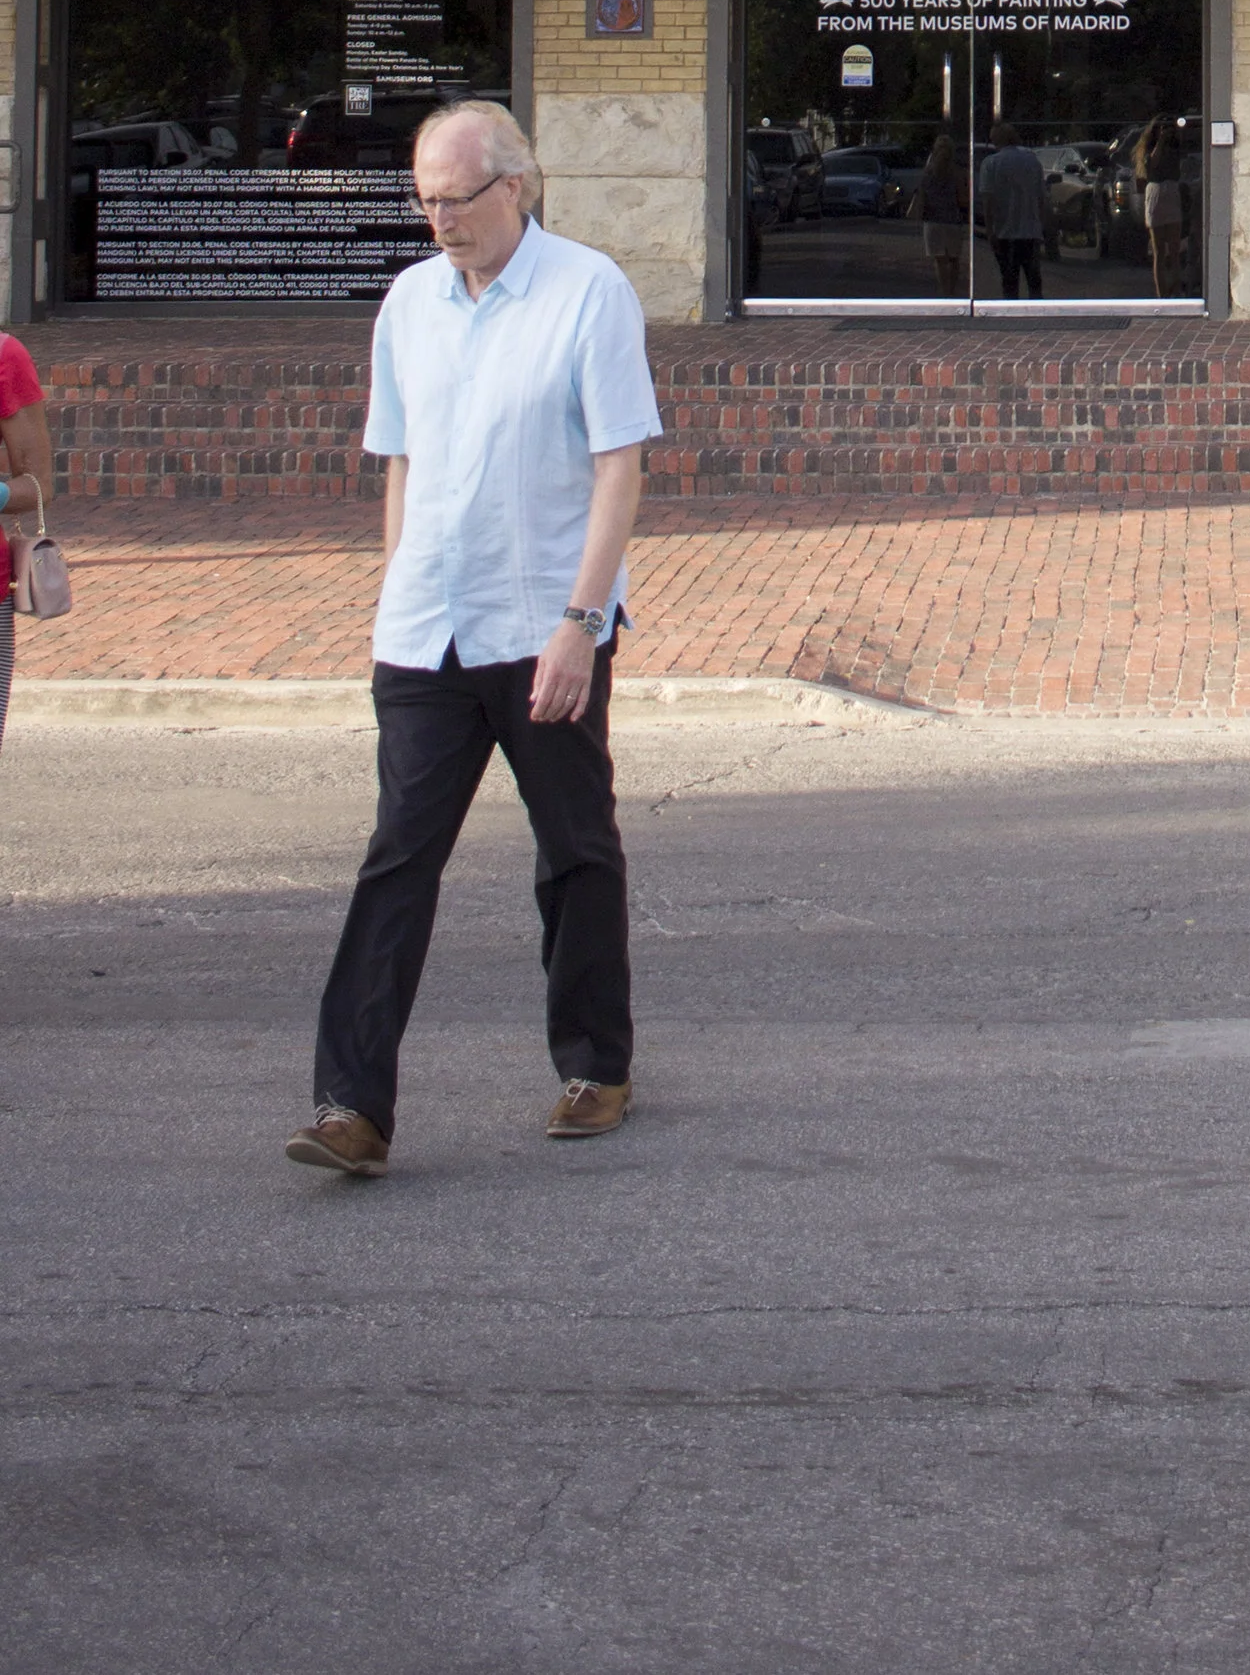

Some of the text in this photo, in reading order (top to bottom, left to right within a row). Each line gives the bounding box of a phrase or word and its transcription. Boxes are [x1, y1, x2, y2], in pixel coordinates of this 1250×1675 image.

[818, 15, 1130, 31] FROM THE MUSEUMS OF MADRID
